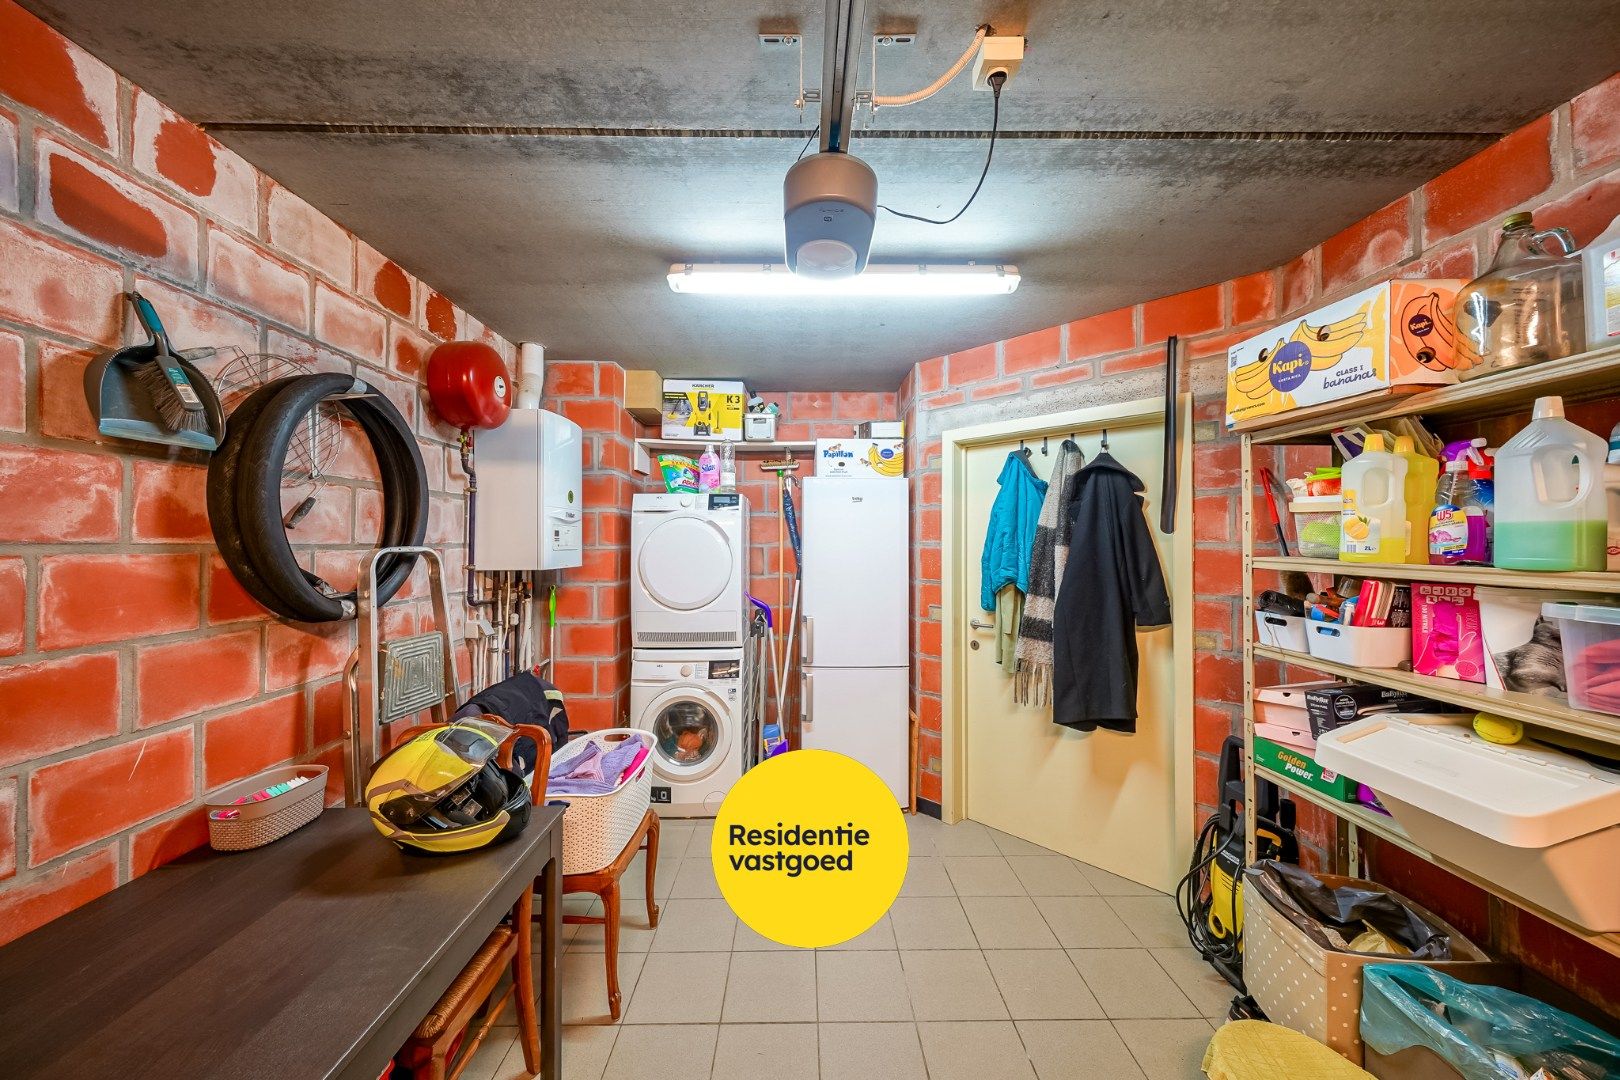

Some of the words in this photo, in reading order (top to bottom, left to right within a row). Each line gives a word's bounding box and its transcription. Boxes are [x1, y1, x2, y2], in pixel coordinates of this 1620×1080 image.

[1272, 354, 1304, 374] Kapi
[1336, 366, 1358, 377] CLASS
[1323, 368, 1377, 389] bananas
[726, 395, 733, 404] K
[734, 395, 741, 404] 3
[1436, 509, 1452, 521] W5
[1277, 750, 1307, 770] Golden
[1284, 762, 1314, 780] Power
